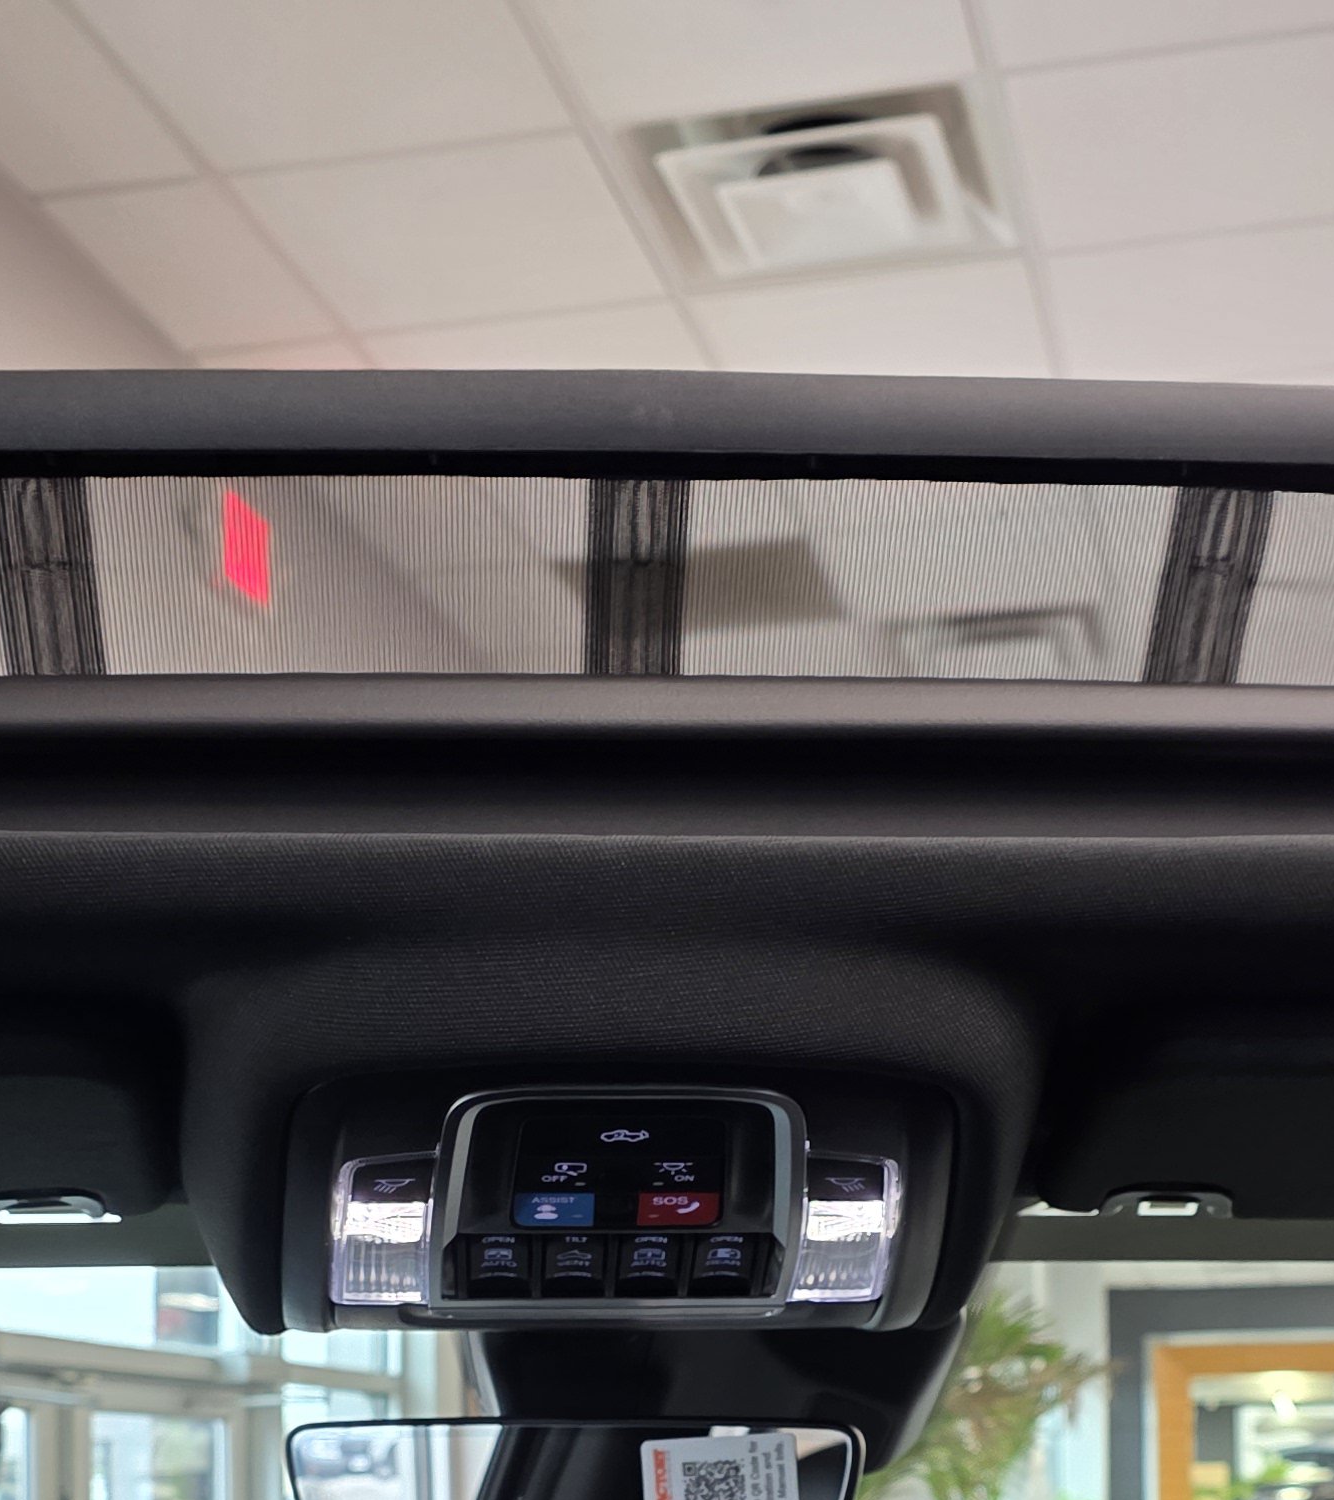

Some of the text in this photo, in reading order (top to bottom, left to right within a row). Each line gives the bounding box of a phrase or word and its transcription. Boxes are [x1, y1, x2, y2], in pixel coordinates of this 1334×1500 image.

[541, 1174, 568, 1183] OFF
[674, 1174, 695, 1183] ON
[531, 1196, 576, 1204] ASSIST
[652, 1196, 688, 1206] SOS
[481, 1236, 516, 1244] OPEN
[634, 1236, 668, 1244] OPEN
[709, 1236, 744, 1244] OPEN
[481, 1260, 517, 1268] AUTO
[631, 1260, 667, 1268] AUTO
[748, 1440, 759, 1454] for
[763, 1452, 772, 1470] and
[750, 1456, 760, 1480] Code
[777, 1463, 787, 1499] Manual
[751, 1482, 763, 1497] QR
